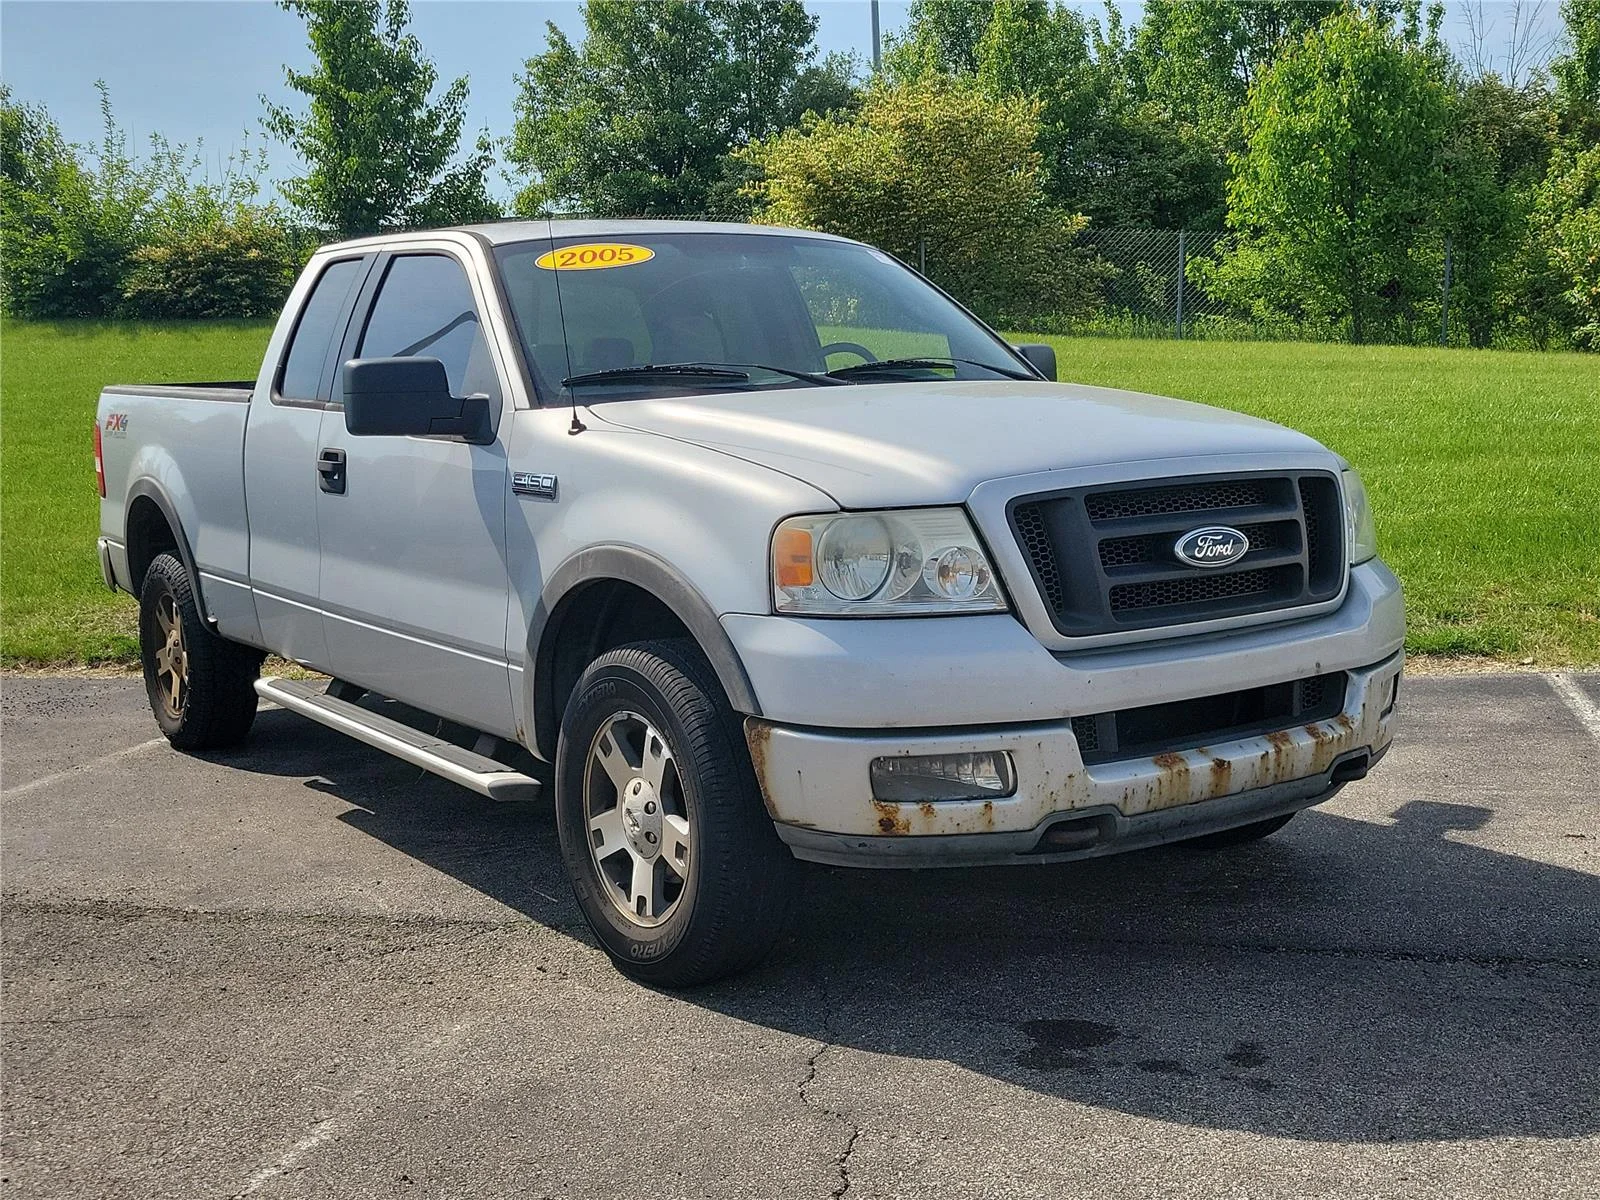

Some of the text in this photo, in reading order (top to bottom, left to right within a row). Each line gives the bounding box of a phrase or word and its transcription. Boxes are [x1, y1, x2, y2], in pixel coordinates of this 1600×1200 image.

[559, 247, 634, 267] 2005
[105, 412, 129, 432] FX4
[1194, 534, 1234, 558] Ford
